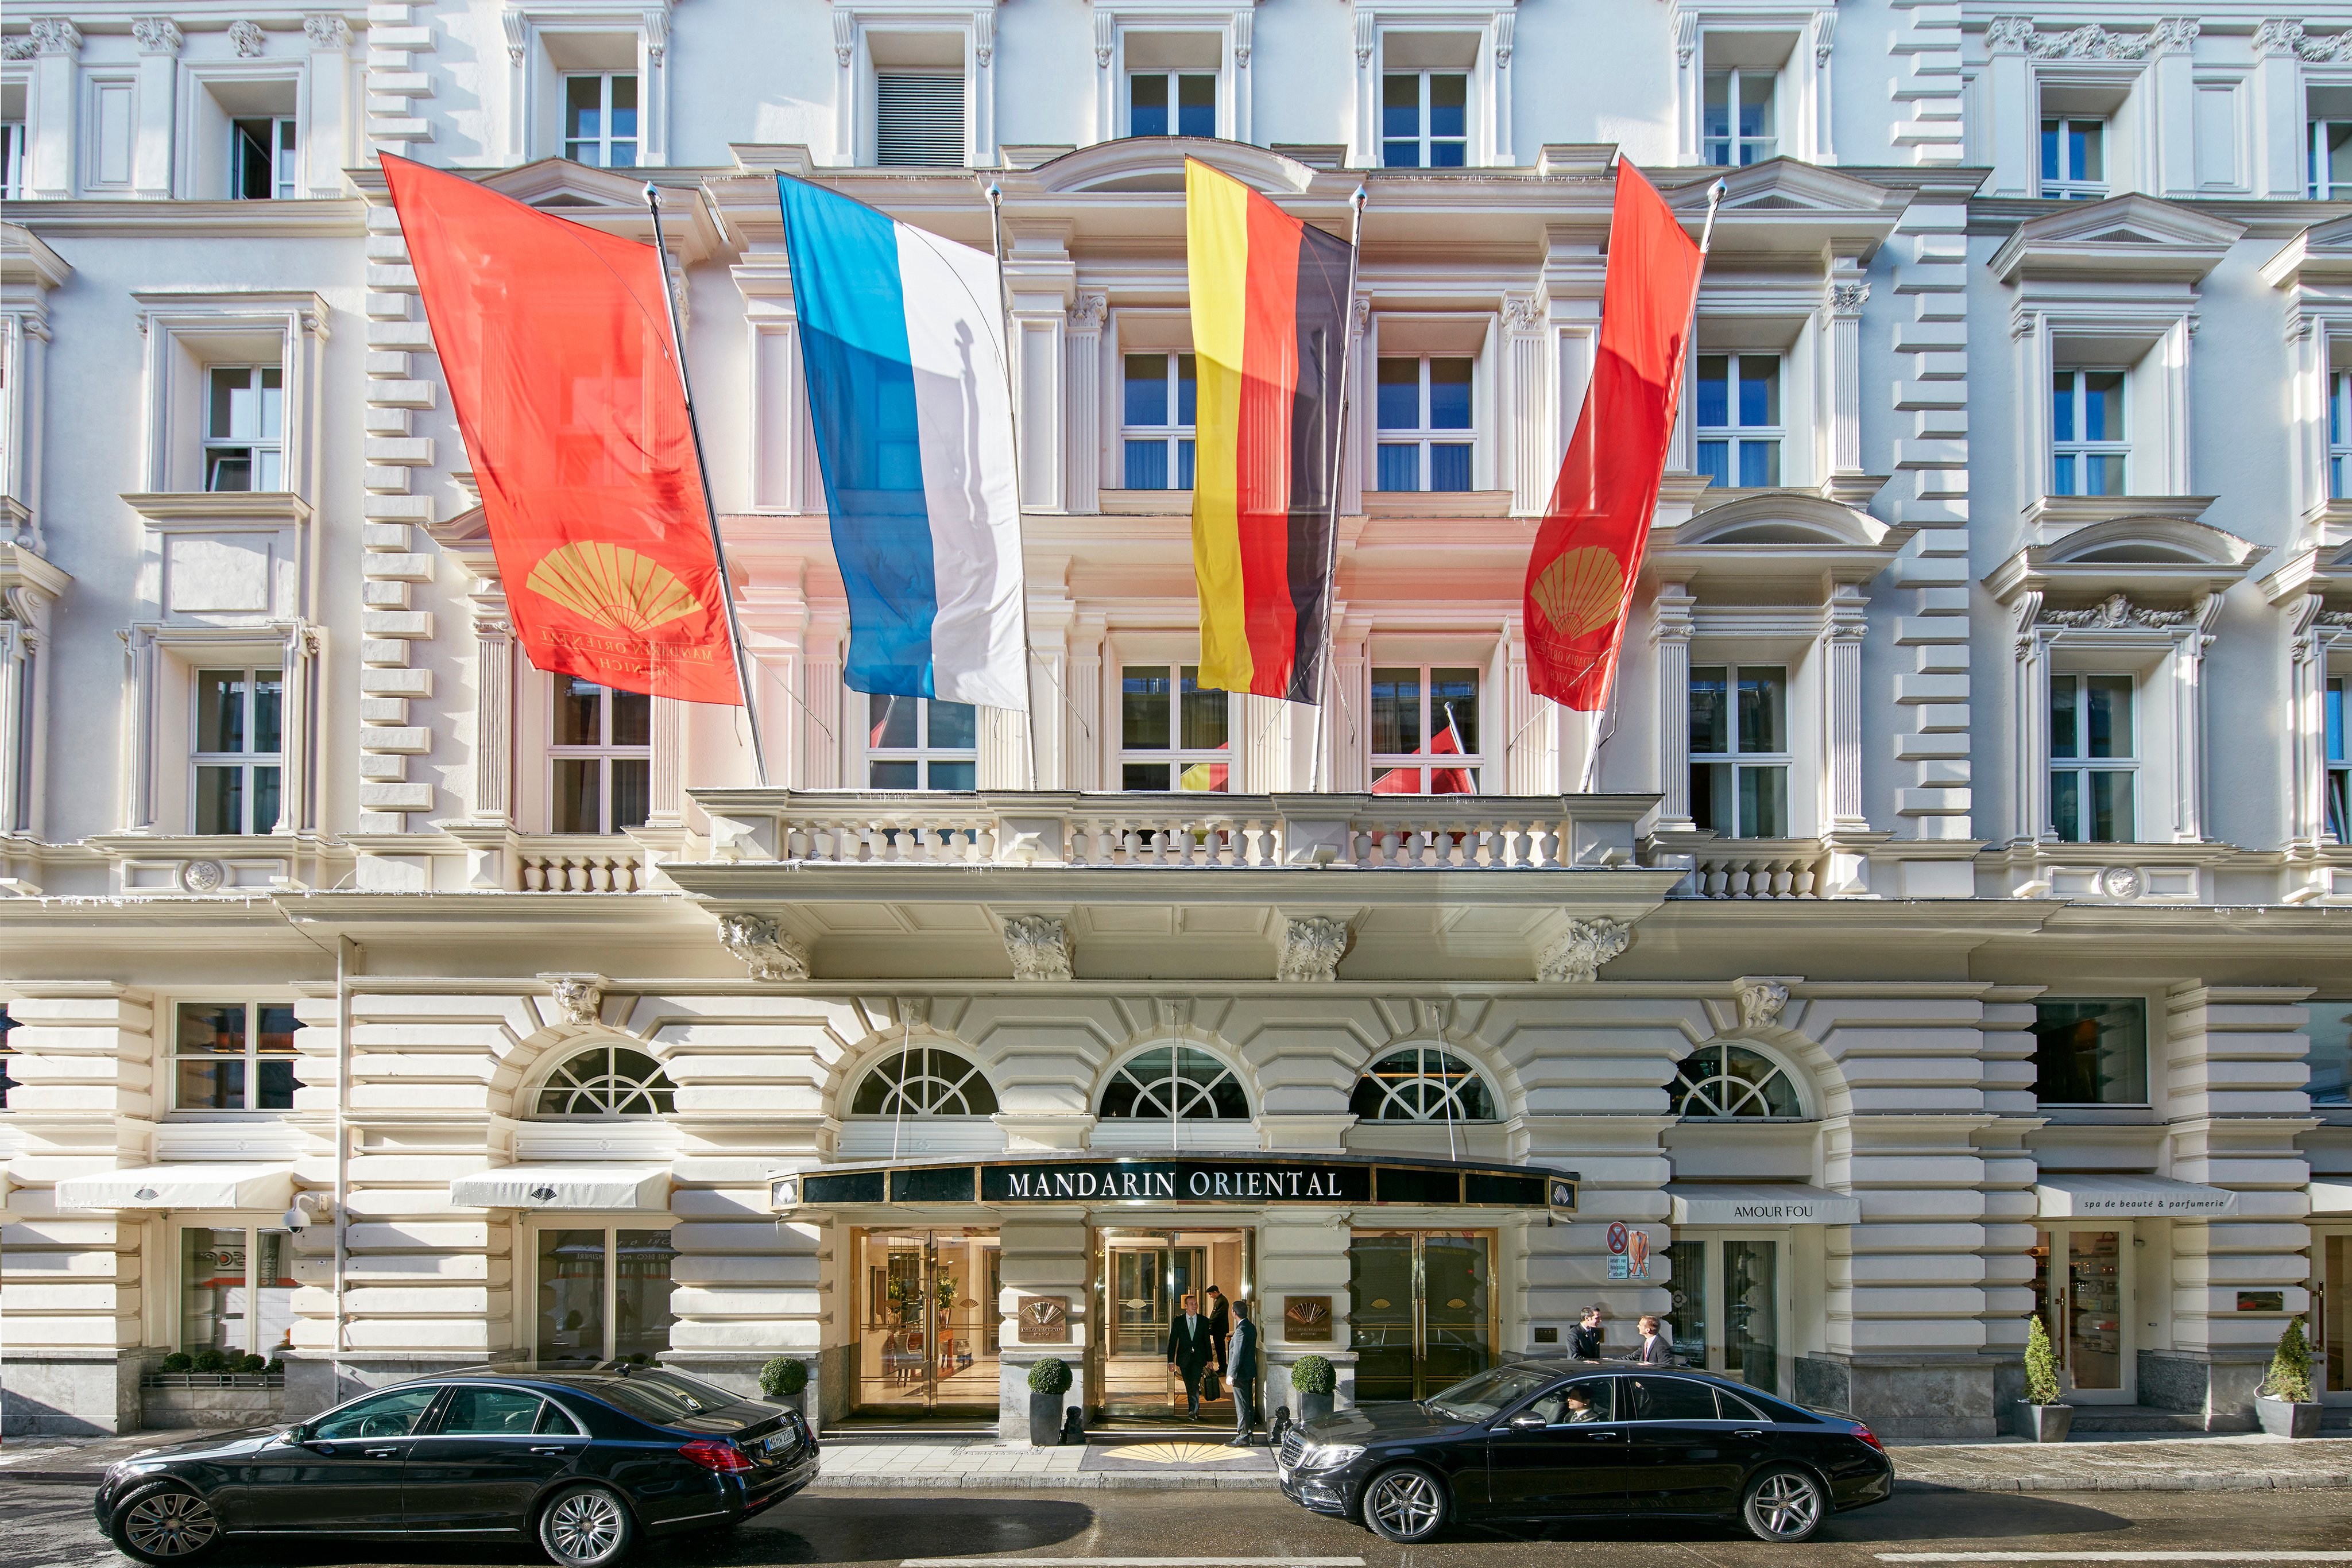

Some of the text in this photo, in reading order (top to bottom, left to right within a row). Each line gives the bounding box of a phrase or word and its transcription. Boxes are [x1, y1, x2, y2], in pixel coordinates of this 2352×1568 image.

[1008, 1171, 1342, 1197] MANDARIN ORIENTAL
[2169, 1200, 2224, 1209] parfumerie
[1734, 1206, 1813, 1217] AMOUR FOU
